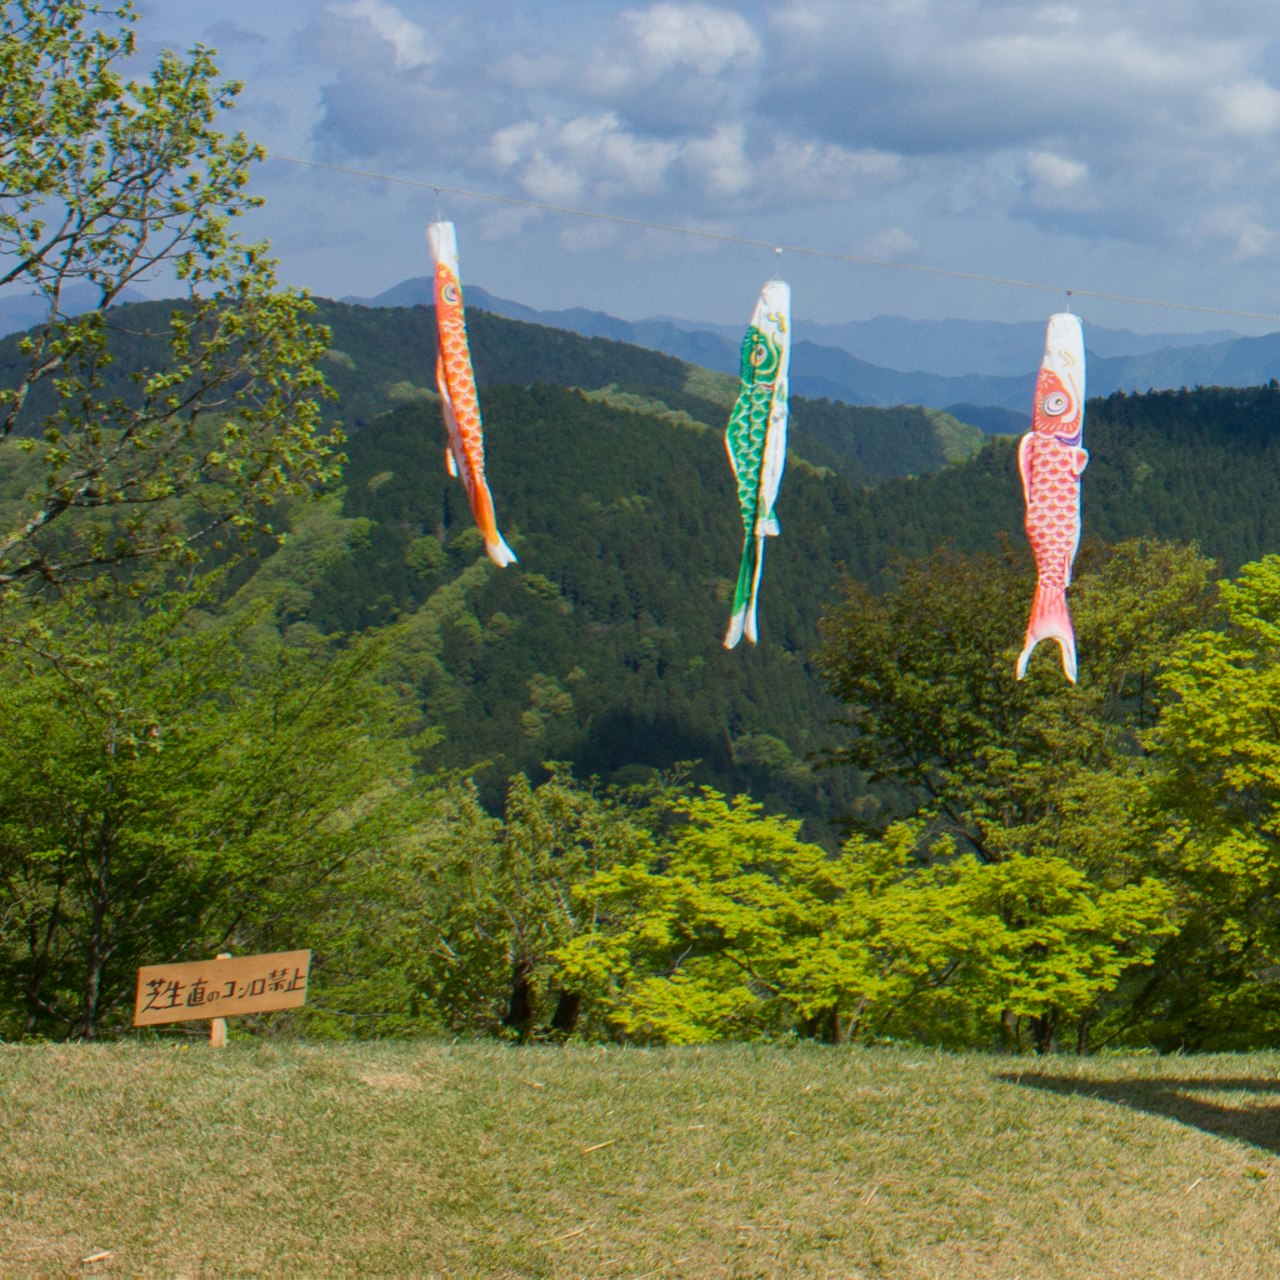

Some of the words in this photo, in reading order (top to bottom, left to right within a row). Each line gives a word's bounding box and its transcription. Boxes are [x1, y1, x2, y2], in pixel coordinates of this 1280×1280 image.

[141, 967, 306, 1013] 芝生直のコンロ禁止
